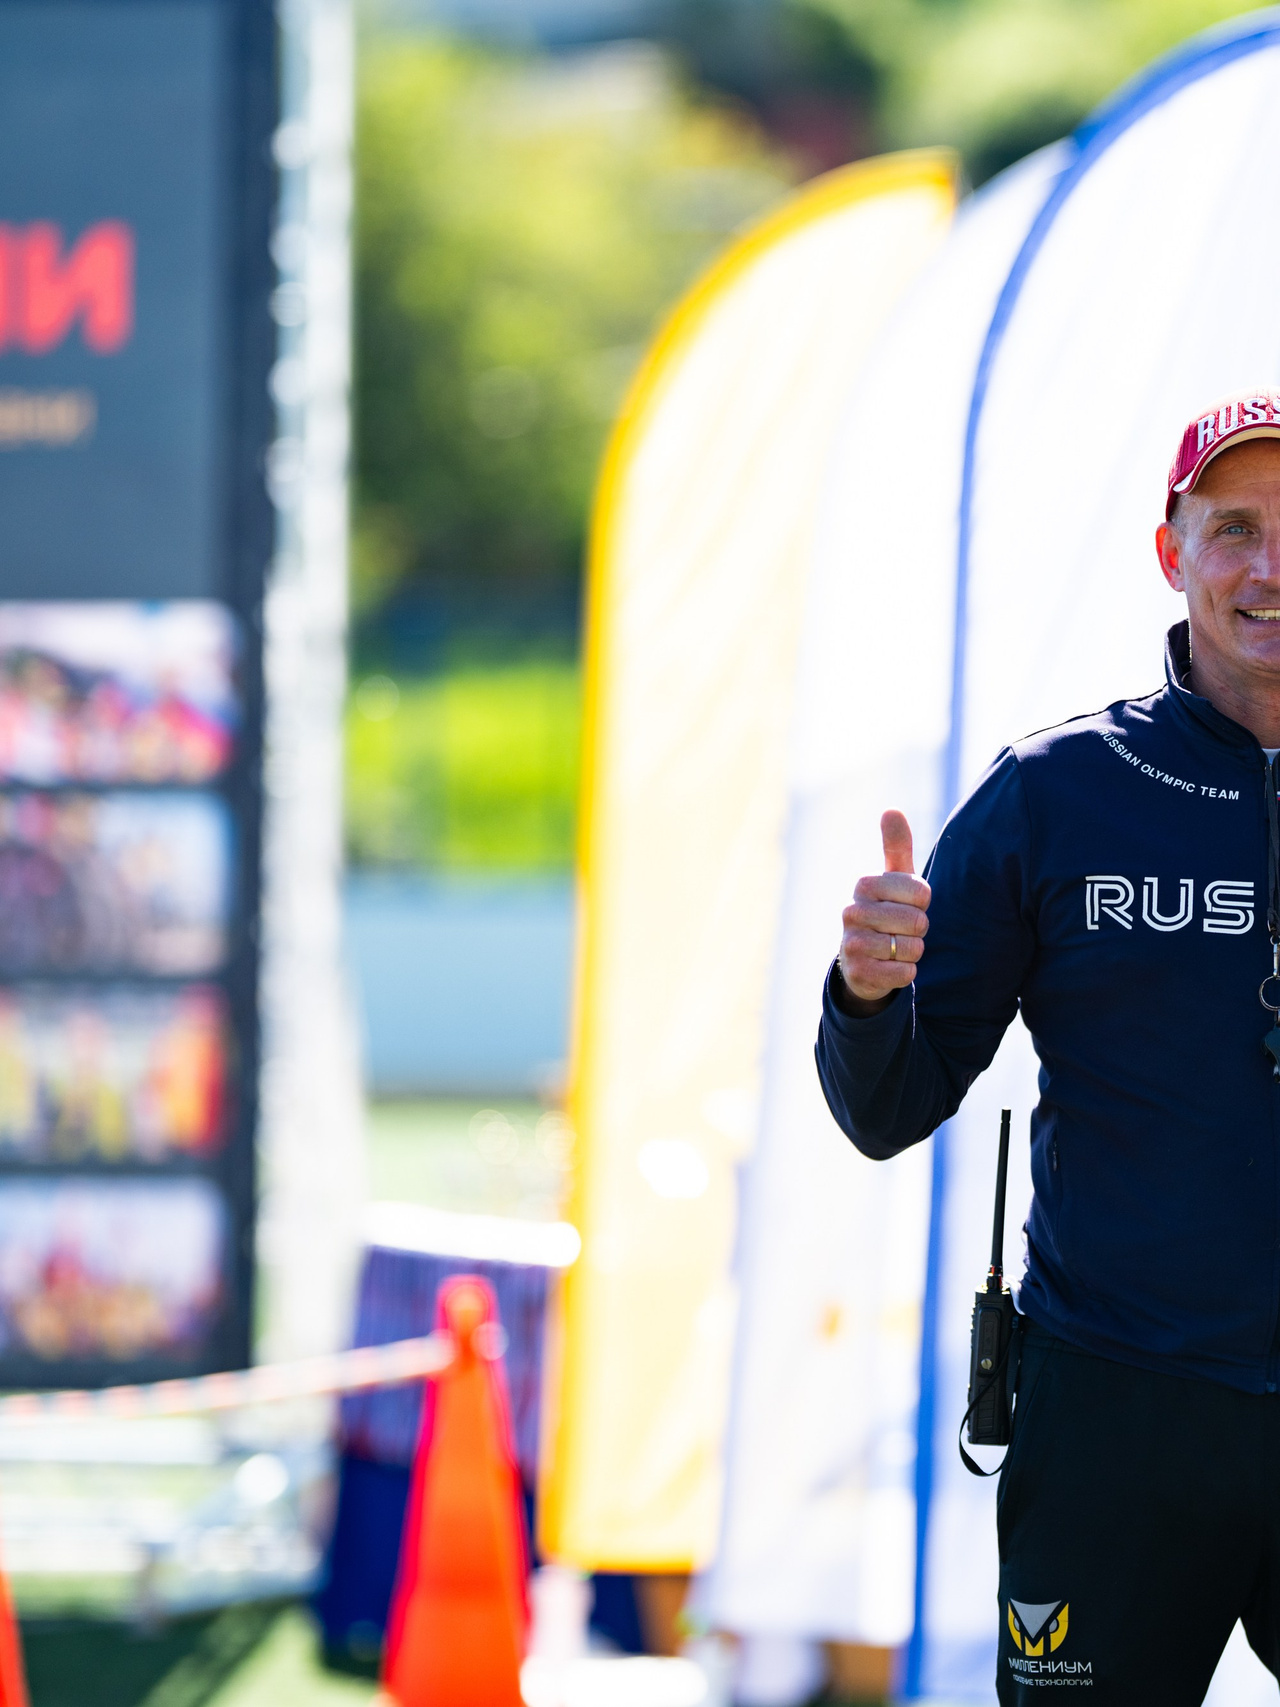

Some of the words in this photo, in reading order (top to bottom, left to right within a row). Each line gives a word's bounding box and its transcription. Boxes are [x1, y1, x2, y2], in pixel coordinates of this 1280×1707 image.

[1099, 728, 1142, 767] RUSSIAN
[1140, 763, 1196, 793] OLYMPIC
[1200, 785, 1240, 801] TEAM
[1035, 1677, 1093, 1687] ТЕХНОЛОГИЙ
